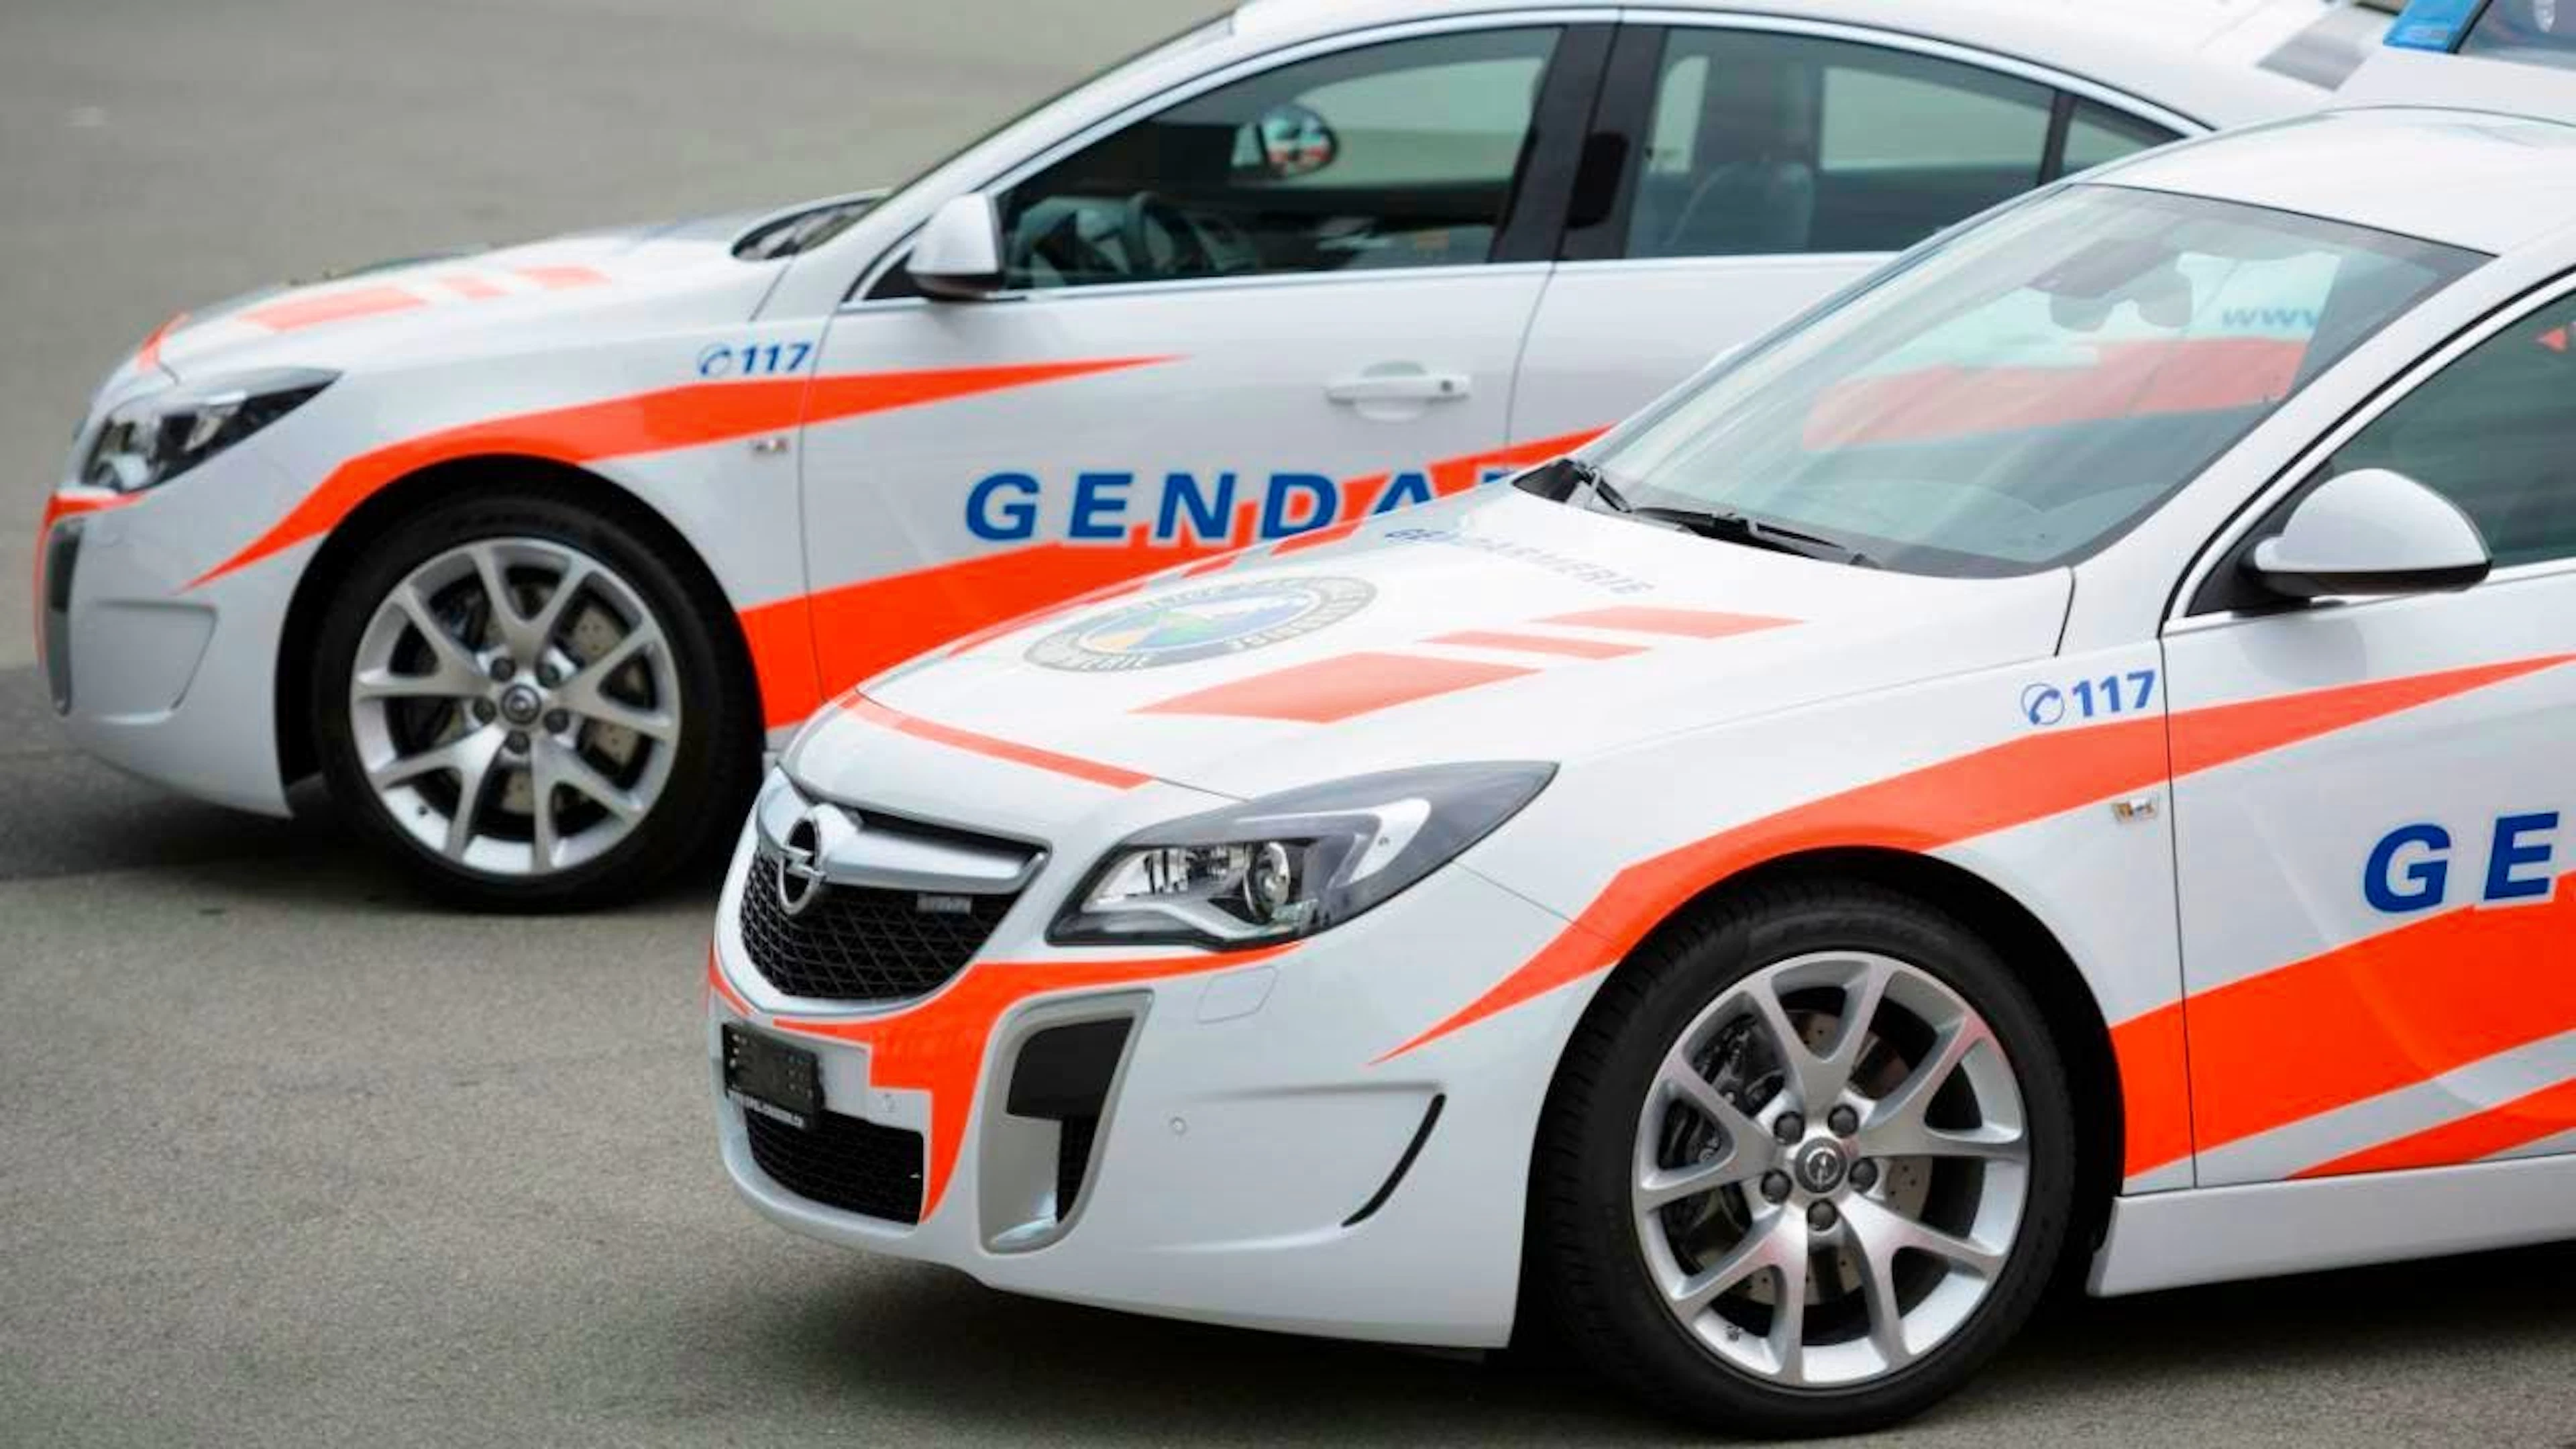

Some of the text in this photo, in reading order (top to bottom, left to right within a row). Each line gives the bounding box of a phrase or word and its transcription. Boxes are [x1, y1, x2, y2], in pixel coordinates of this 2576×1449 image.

[741, 341, 813, 373] 117
[966, 472, 1512, 542] GENDA
[2072, 669, 2156, 718] 117
[2364, 810, 2560, 913] GE
